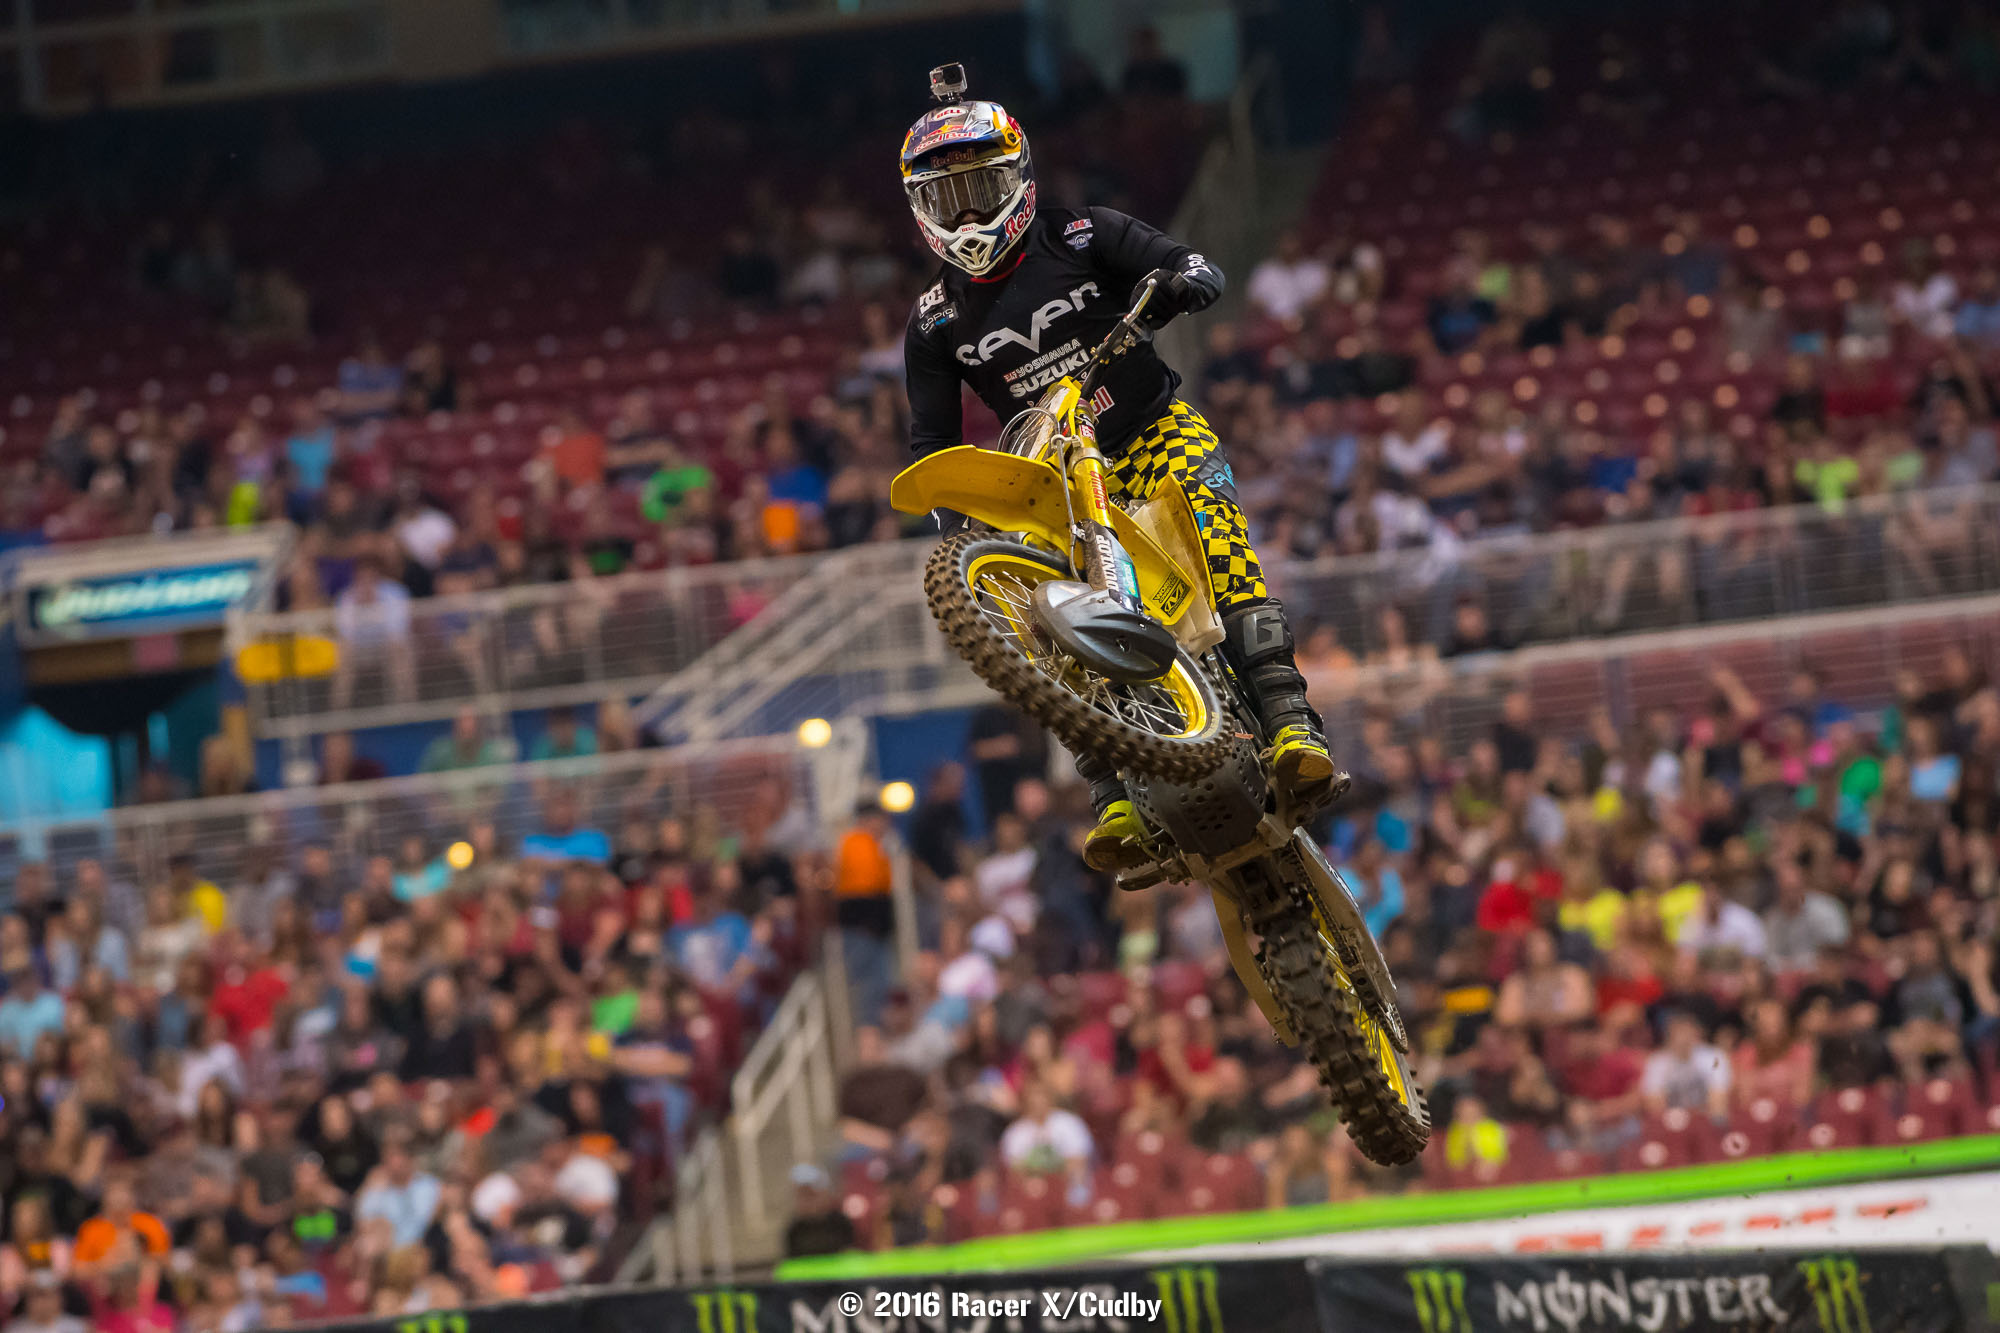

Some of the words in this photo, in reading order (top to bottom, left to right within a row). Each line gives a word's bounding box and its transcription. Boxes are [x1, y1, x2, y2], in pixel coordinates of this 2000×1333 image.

[936, 109, 962, 119] BELL
[1004, 190, 1033, 245] Red
[920, 308, 953, 331] GoPro
[1009, 348, 1090, 398] SUZUKI
[1015, 338, 1082, 378] YOSHIMURA
[1091, 385, 1115, 417] ull
[1096, 534, 1120, 592] DUNLOP
[1494, 1269, 1788, 1333] MONSTER
